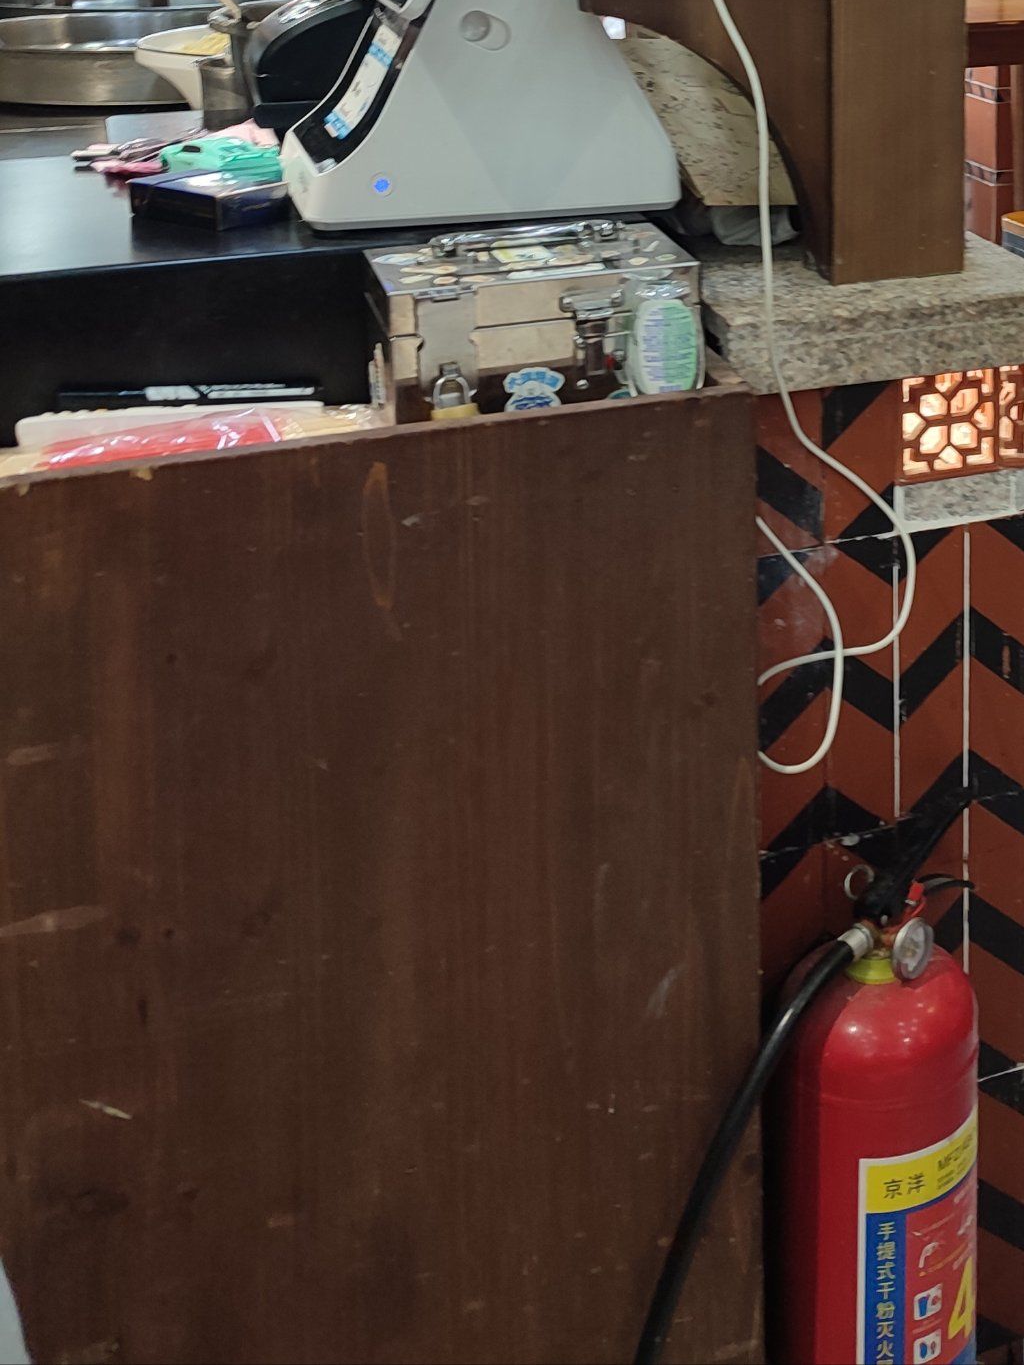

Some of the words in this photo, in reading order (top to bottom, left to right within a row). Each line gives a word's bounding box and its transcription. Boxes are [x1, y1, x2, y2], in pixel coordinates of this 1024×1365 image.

[883, 1173, 925, 1199] 京洋
[876, 1222, 897, 1365] 手提式干粉灭火
